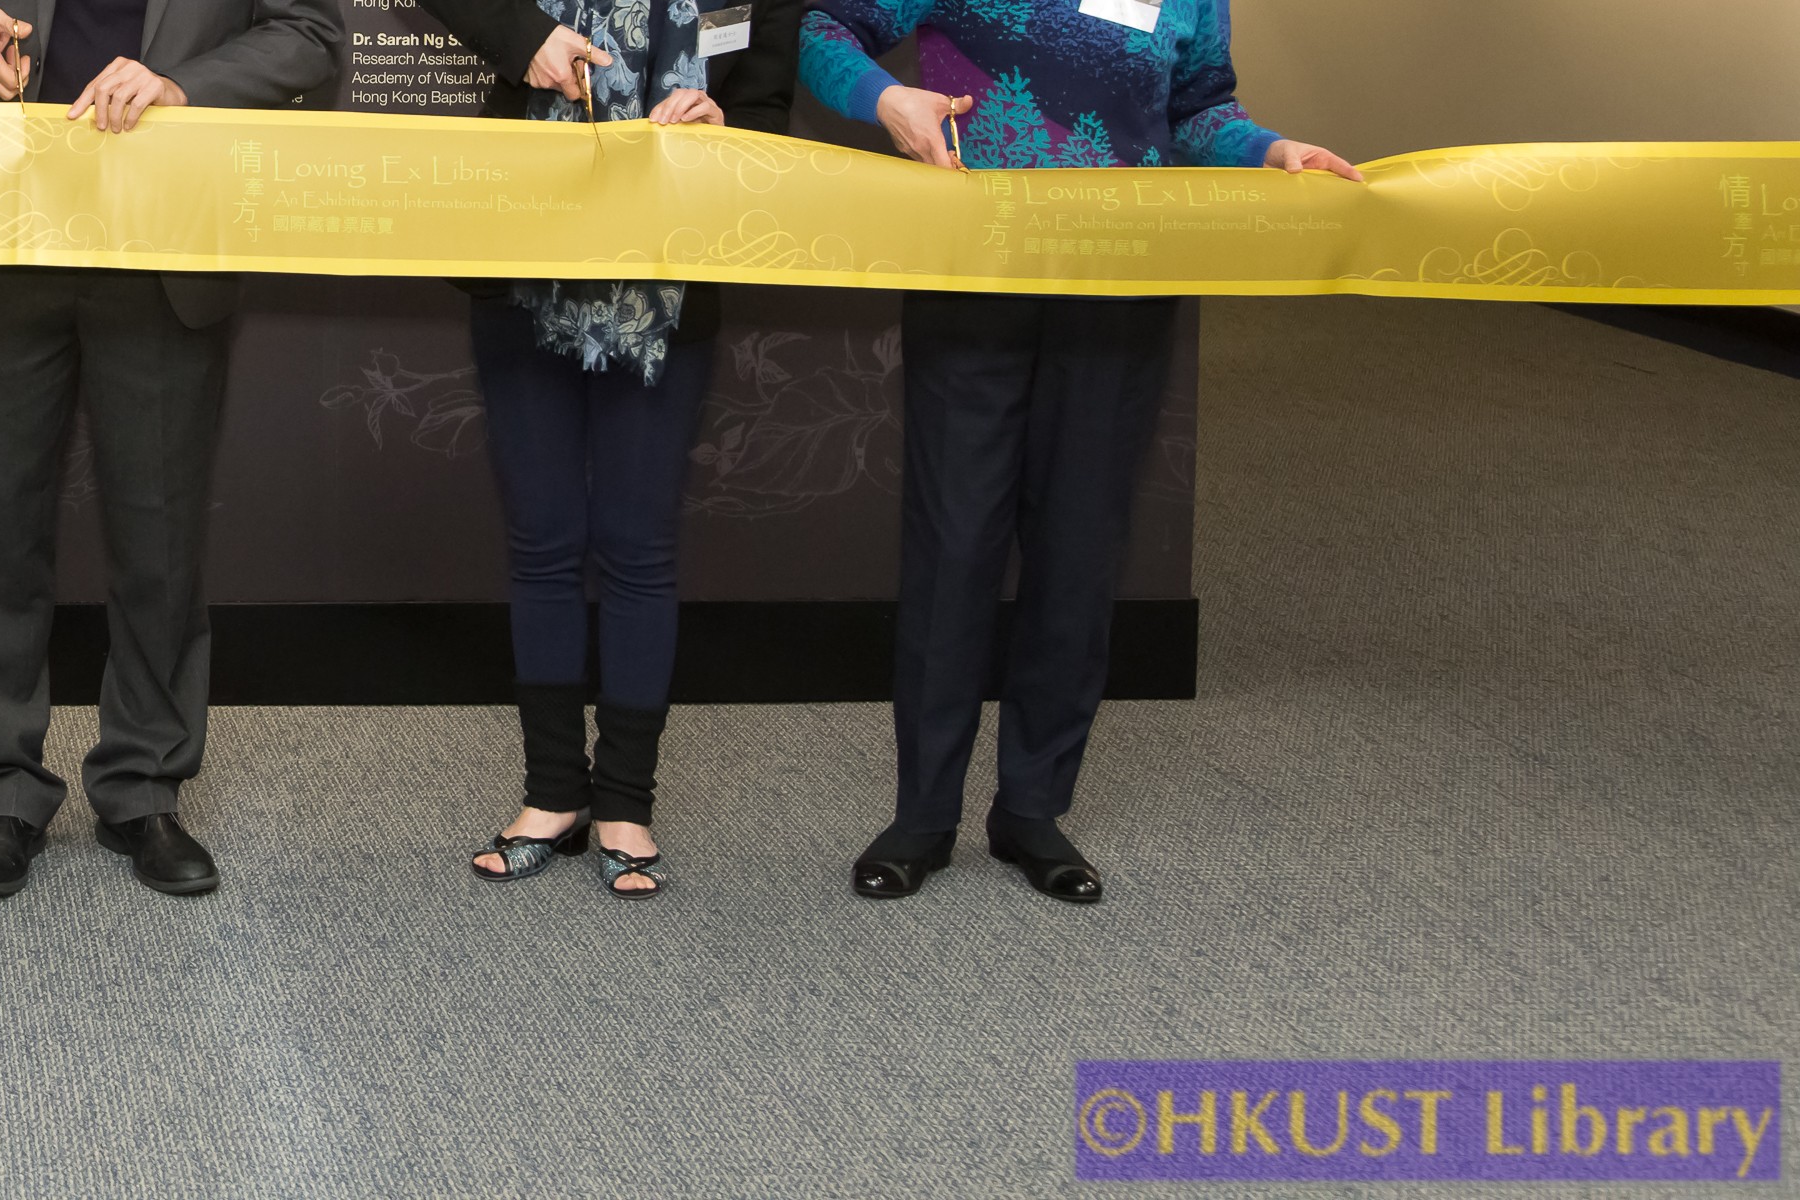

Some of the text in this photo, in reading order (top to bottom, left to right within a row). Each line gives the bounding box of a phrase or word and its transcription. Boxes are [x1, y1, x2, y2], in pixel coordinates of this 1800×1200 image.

[353, 33, 444, 49] Dr. Sarah Ng
[353, 52, 477, 65] Research Assistant
[352, 71, 414, 87] Academy
[418, 72, 431, 84] of
[434, 72, 472, 84] Visual
[352, 90, 477, 106] Hong Kong Baptist
[273, 150, 509, 189] Loving Ex Libris:
[1024, 176, 1267, 210] Loving Ex Libris:
[273, 190, 583, 216] An Exhibition on International Bookplates
